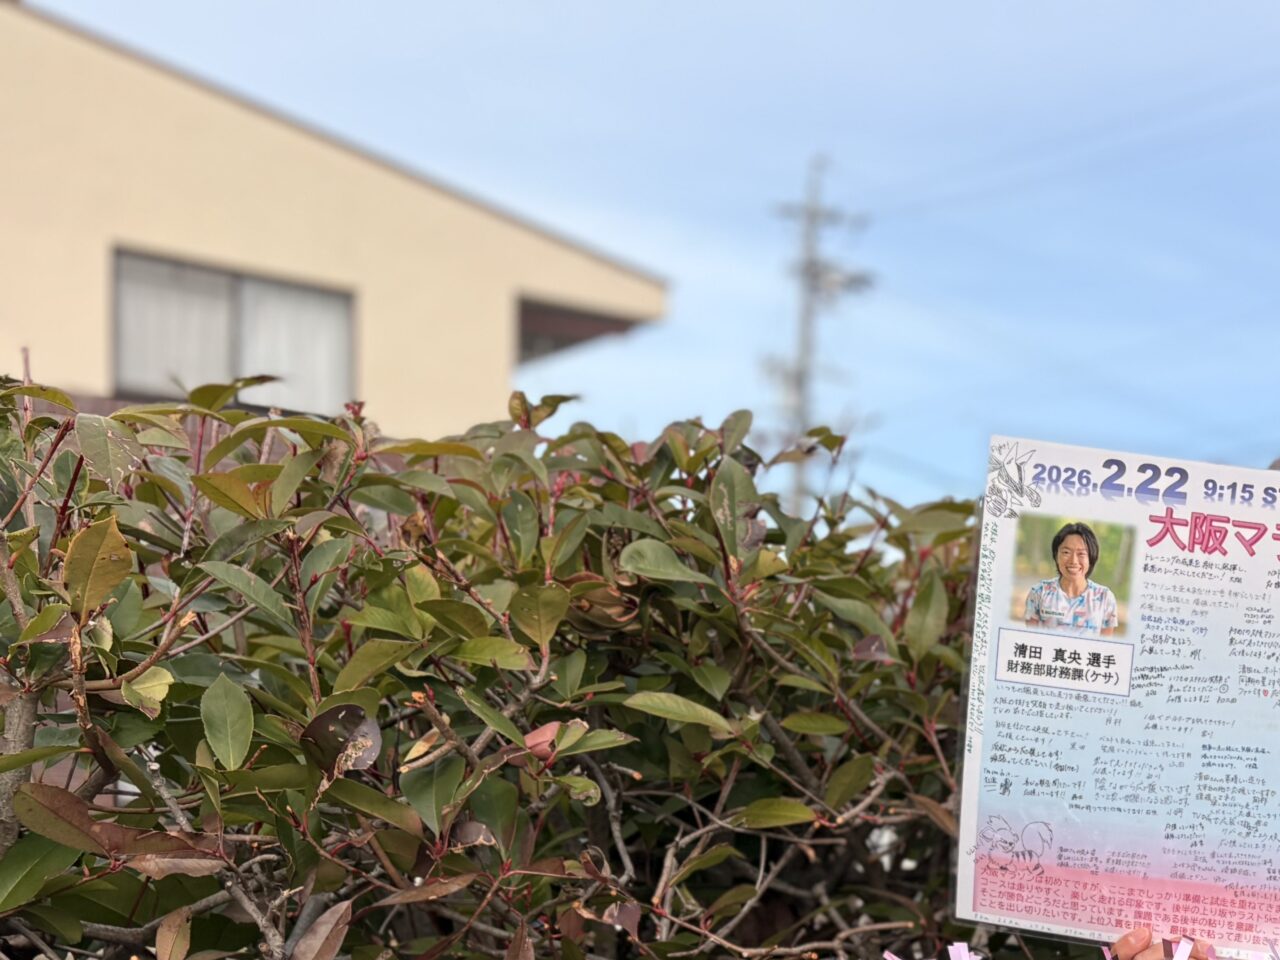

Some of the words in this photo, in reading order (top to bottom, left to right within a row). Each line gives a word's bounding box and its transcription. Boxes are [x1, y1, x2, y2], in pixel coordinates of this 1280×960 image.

[1031, 458, 1190, 501] 2026.2.22
[1203, 479, 1255, 503] 9:15
[1013, 642, 1043, 660] 清田
[1052, 647, 1081, 666] 真央
[1087, 650, 1117, 668] 選手
[1006, 660, 1120, 688] 財務部財務課(ケサ)
